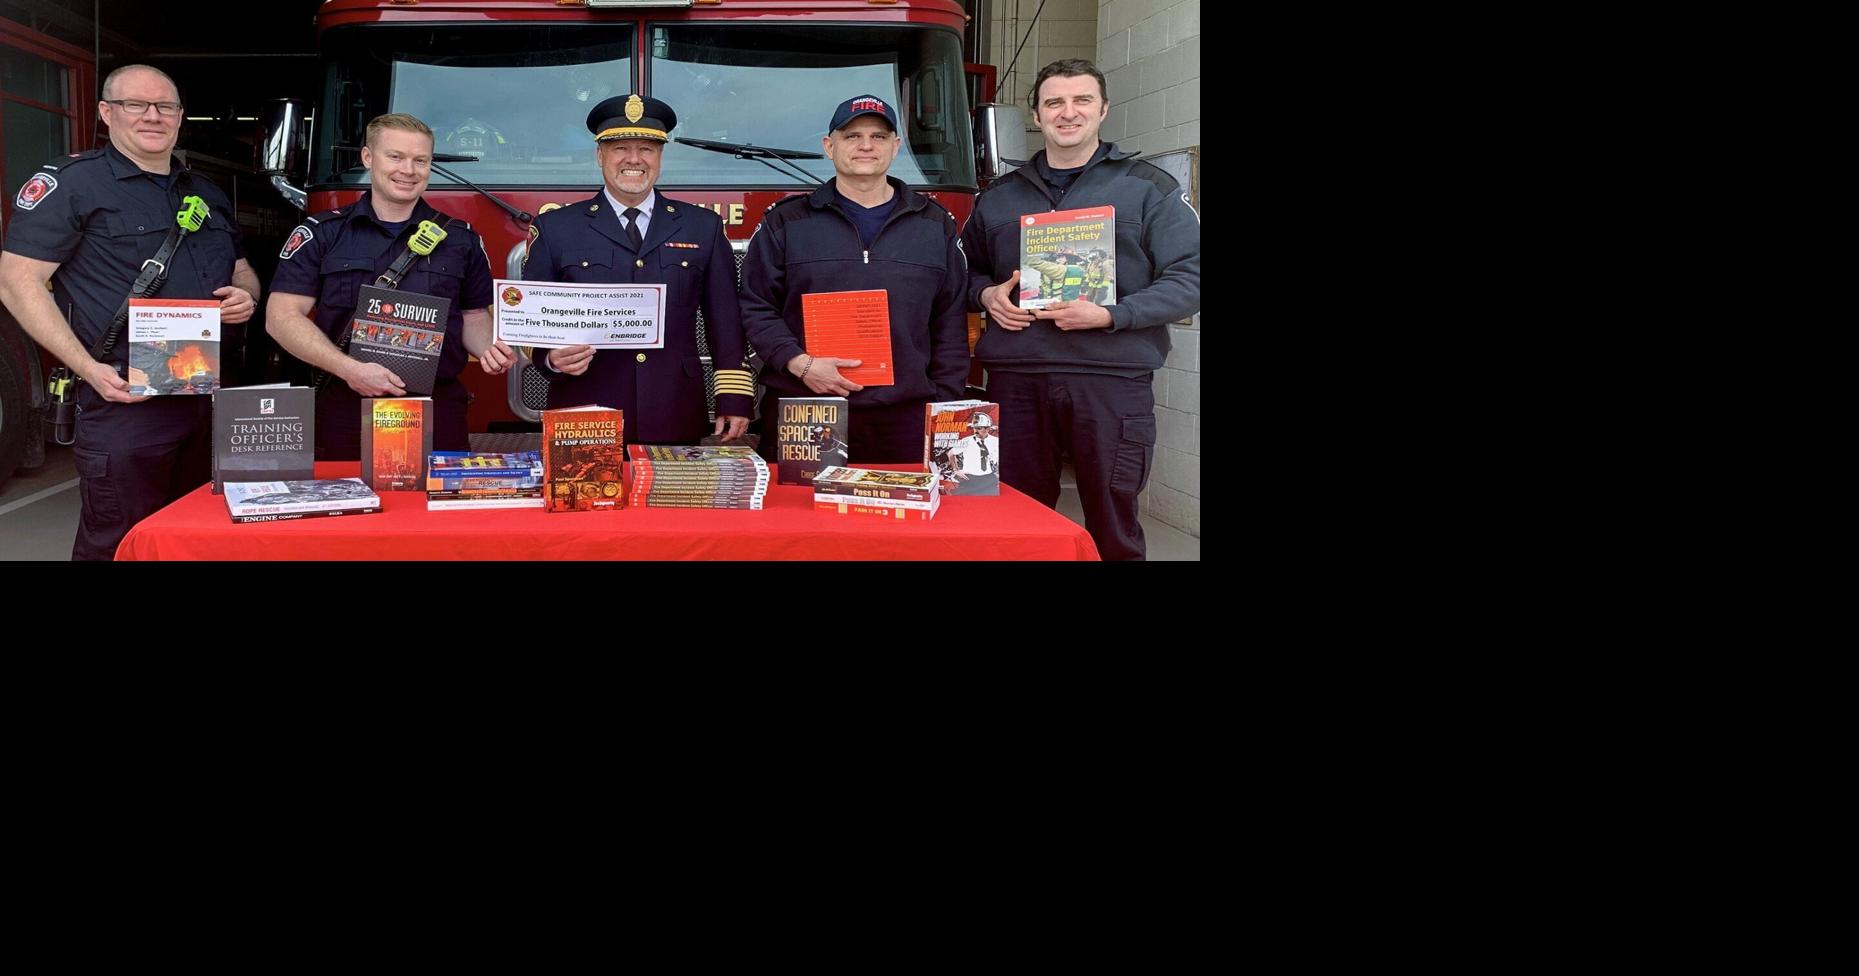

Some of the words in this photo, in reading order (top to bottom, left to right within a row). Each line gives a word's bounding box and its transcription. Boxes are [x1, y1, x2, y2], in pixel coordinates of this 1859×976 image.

[851, 102, 885, 113] FIRE
[460, 137, 483, 147] S-11
[1026, 228, 1044, 237] Fire
[1046, 222, 1105, 235] Department
[1026, 235, 1065, 245] Incident
[1068, 232, 1100, 241] Safety
[1026, 245, 1057, 254] Officer
[367, 298, 382, 315] 25
[393, 302, 439, 324] SURVIVE
[541, 306, 586, 316] Orangeville
[587, 308, 603, 316] Fire
[604, 308, 636, 316] Services
[525, 318, 541, 327] Five
[542, 319, 579, 328] Thousand
[581, 321, 609, 329] Dollars
[612, 319, 653, 328] $5,000.00
[375, 411, 387, 419] THE
[389, 411, 420, 419] EVOLVING
[784, 404, 837, 424] CONFINED
[936, 411, 955, 423] JOHN
[231, 422, 303, 434] TRAINING
[375, 419, 420, 429] FIREGROUND
[555, 422, 576, 430] FIRE
[578, 420, 616, 430] SERVICE
[935, 422, 968, 433] NORMAN
[231, 433, 303, 445] OFFICER'S
[555, 429, 616, 439] HYDRAULICS
[780, 425, 816, 442] SPACE
[231, 445, 254, 453] DESK
[255, 443, 303, 452] REFERENCE
[782, 444, 821, 461] RESCUE
[853, 488, 871, 497] Pass
[879, 490, 890, 498] On
